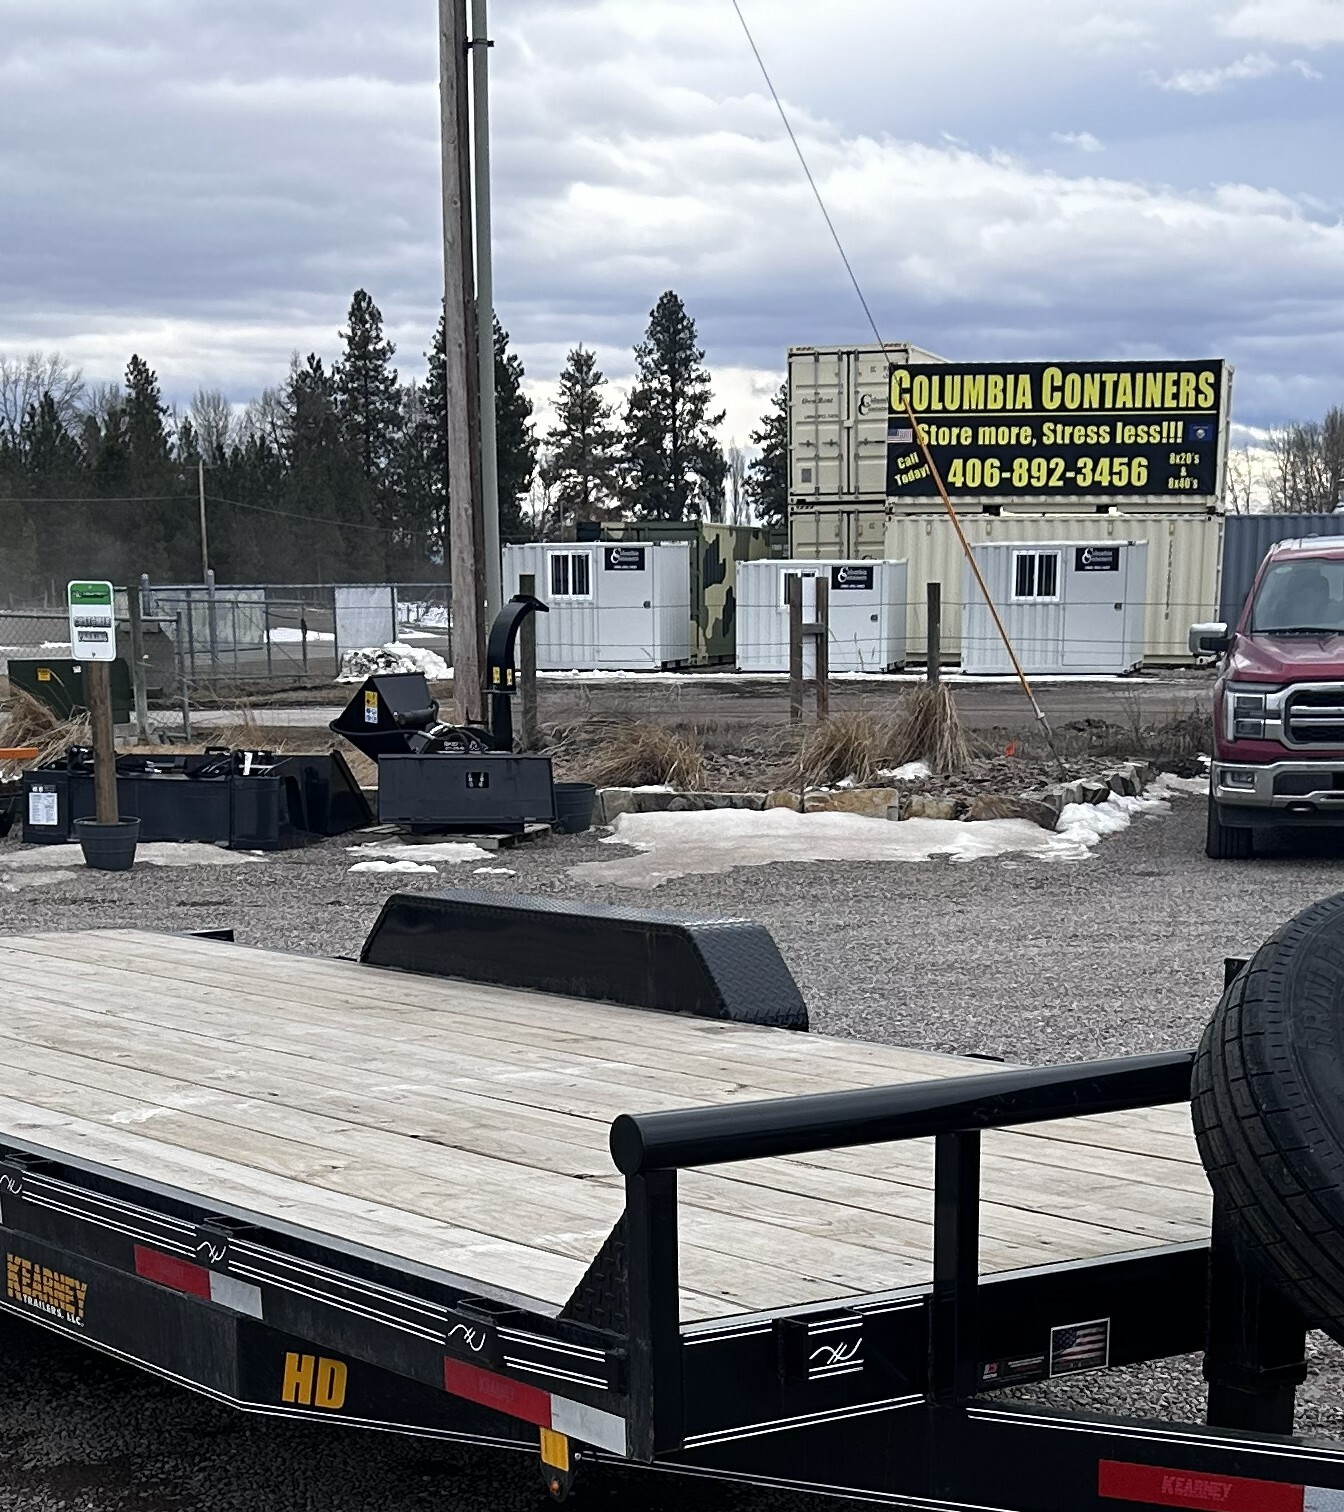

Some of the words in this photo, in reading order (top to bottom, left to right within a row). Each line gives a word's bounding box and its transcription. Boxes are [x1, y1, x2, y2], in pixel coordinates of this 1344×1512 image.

[890, 369, 1033, 412] COLUMBIA
[1042, 366, 1215, 410] CONTAINERS
[917, 423, 973, 446] Store
[978, 425, 1037, 447] more,
[1042, 422, 1111, 445] Stress
[1115, 420, 1184, 445] less!!!
[897, 451, 920, 469] Call
[947, 456, 1149, 488] 406-892-3456
[894, 463, 931, 487] Today!
[7, 1252, 88, 1318] KEARNEY
[282, 1352, 348, 1409] HD
[1162, 1476, 1233, 1499] KEARNEY
